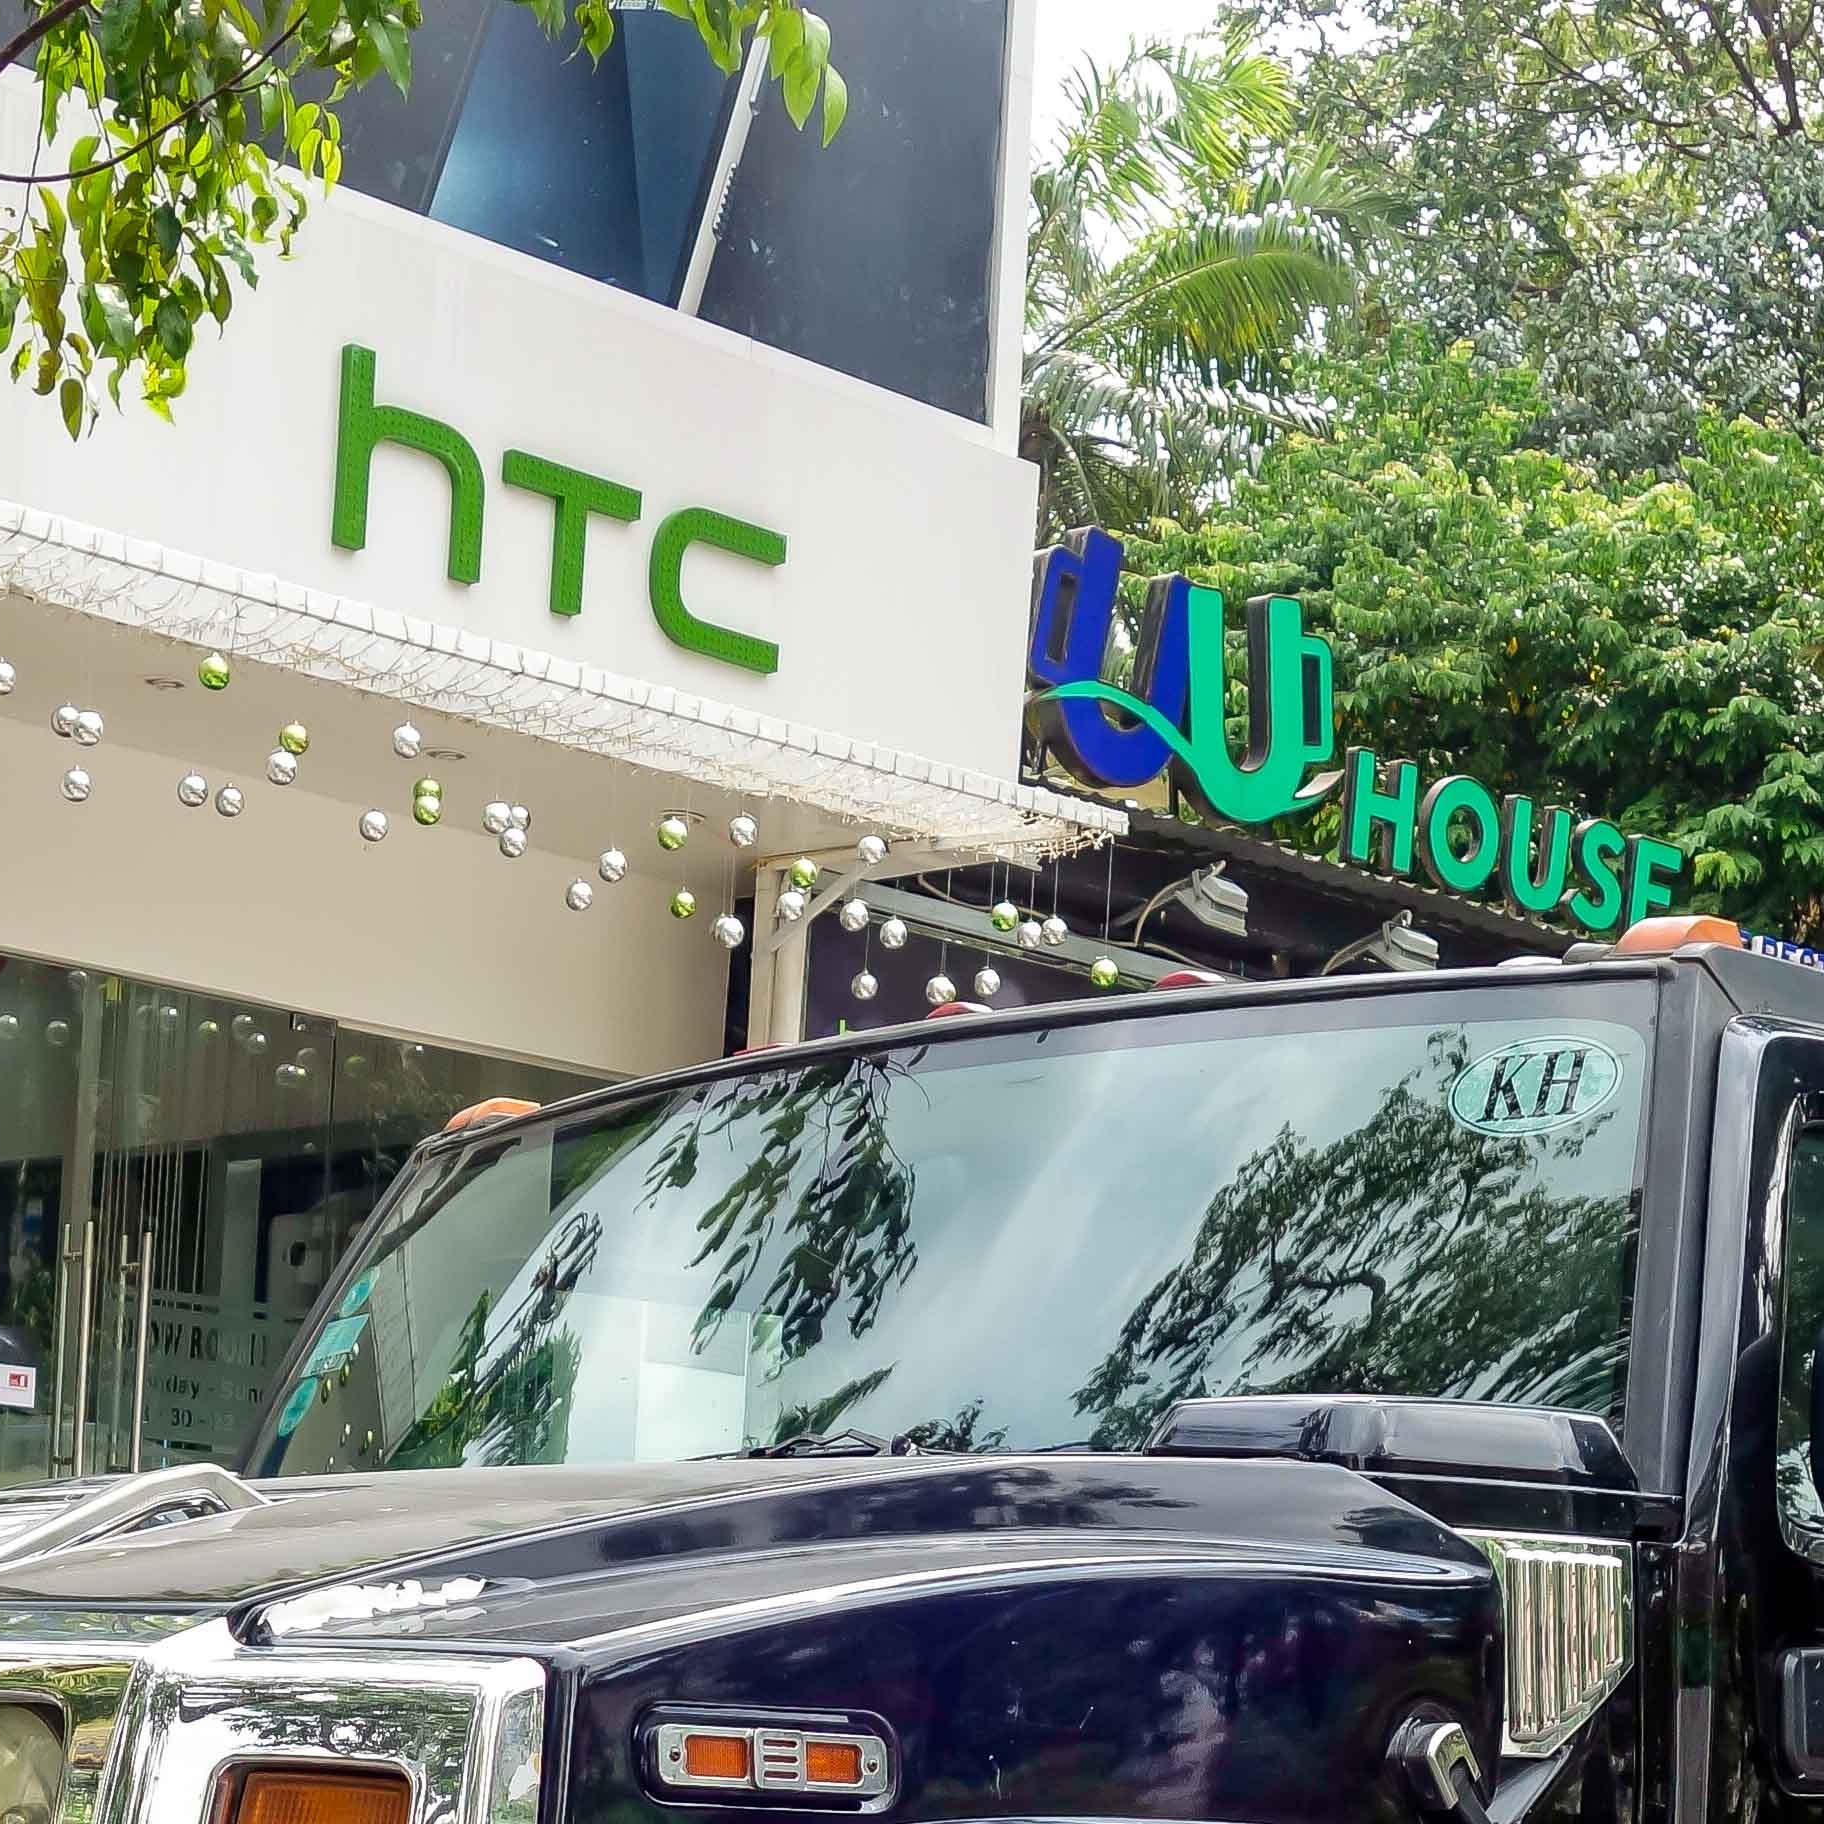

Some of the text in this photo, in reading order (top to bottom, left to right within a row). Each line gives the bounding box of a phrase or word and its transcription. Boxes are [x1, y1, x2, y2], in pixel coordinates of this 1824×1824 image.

[330, 342, 788, 676] htc
[1339, 745, 1684, 930] HOUSE
[1475, 1048, 1593, 1123] KH
